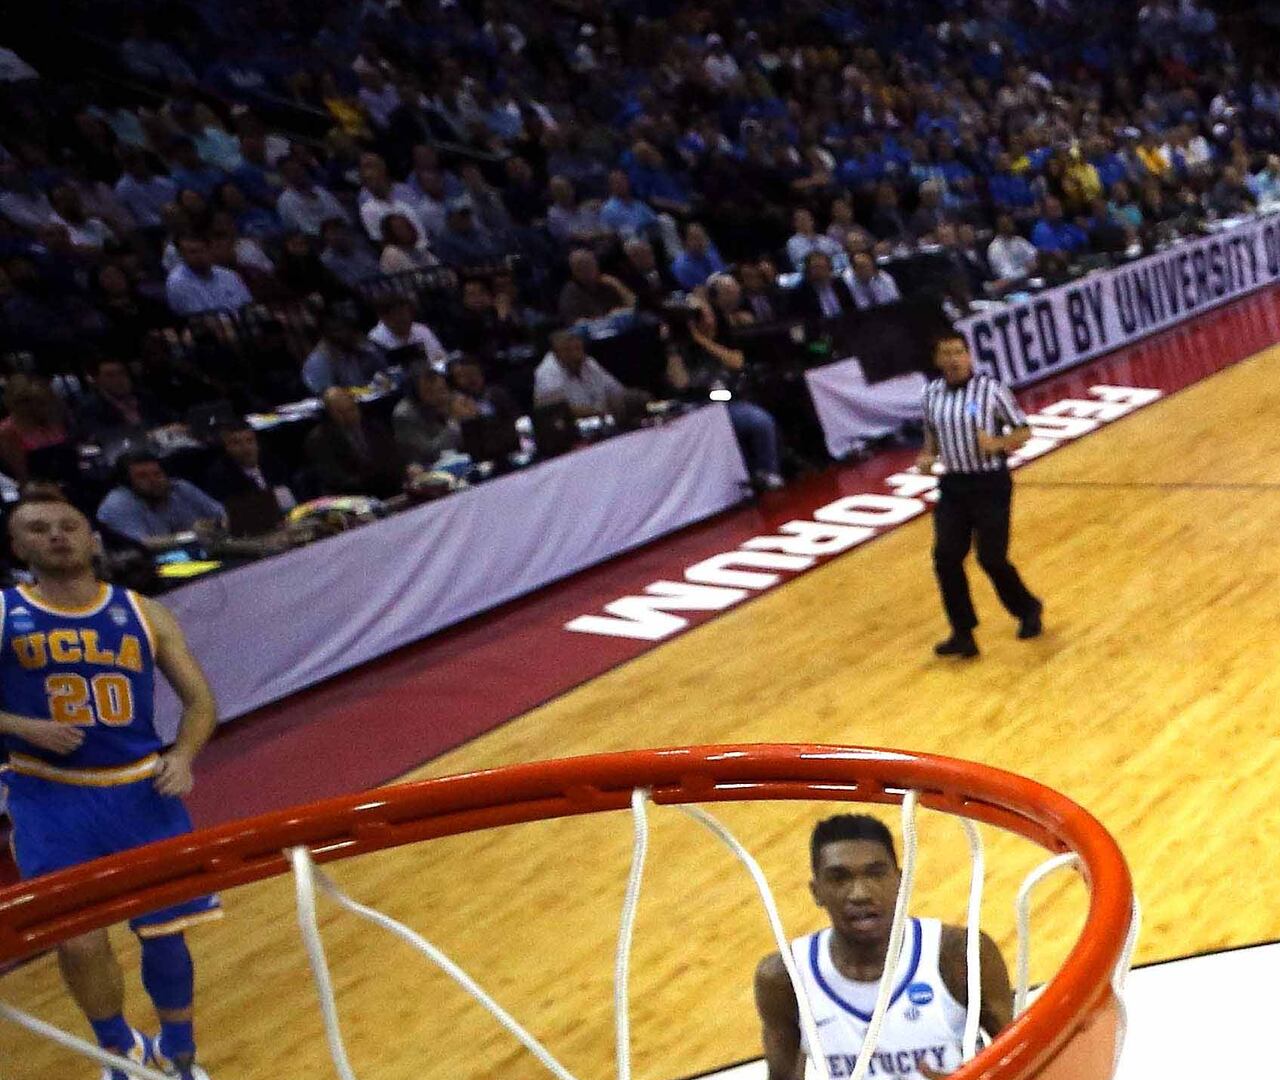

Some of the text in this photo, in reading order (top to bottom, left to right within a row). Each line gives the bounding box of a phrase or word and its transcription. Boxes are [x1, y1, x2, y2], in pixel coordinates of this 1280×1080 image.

[1066, 280, 1110, 354] BY
[1112, 233, 1259, 335] UNIVERSITY
[11, 628, 144, 673] UCLA
[44, 672, 134, 728] 20
